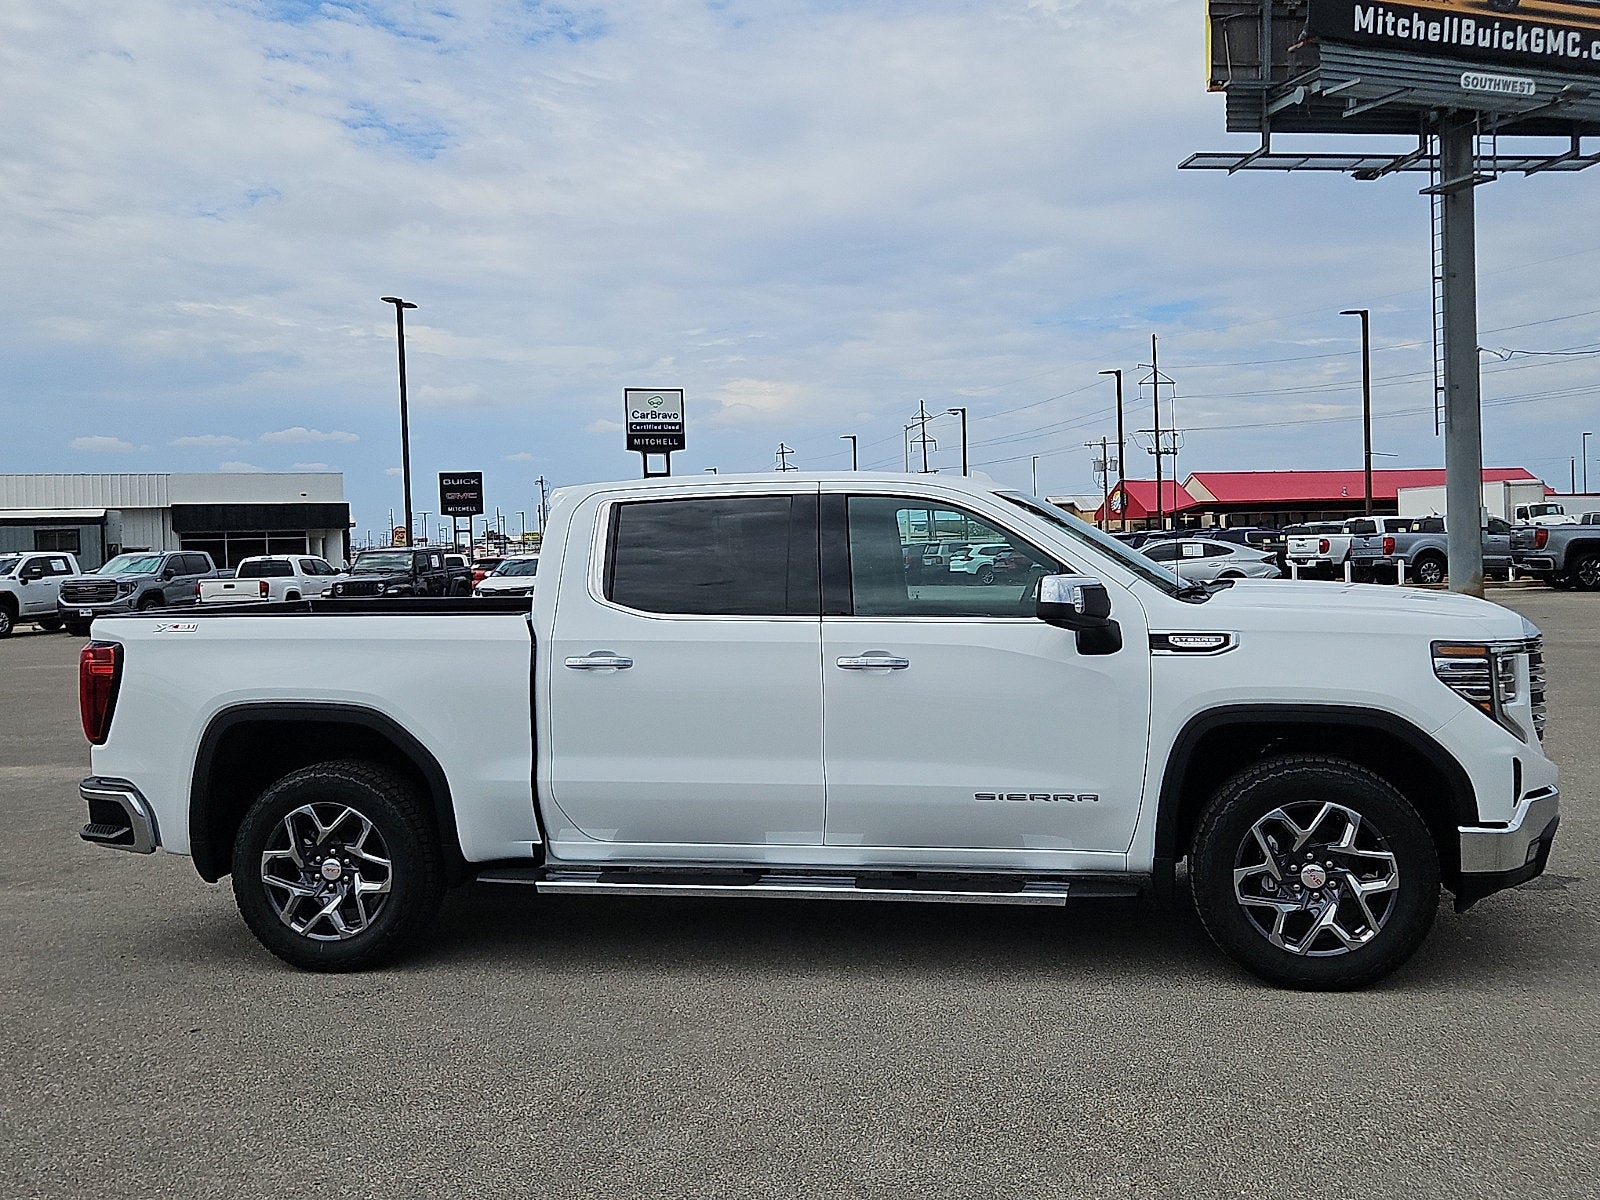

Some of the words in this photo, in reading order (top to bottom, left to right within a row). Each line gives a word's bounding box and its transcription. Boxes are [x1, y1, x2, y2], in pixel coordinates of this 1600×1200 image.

[1463, 75, 1533, 93] SOUTHWEST
[632, 410, 679, 419] CarBravo
[445, 492, 478, 500] GMC
[974, 792, 1099, 802] SIERRA
